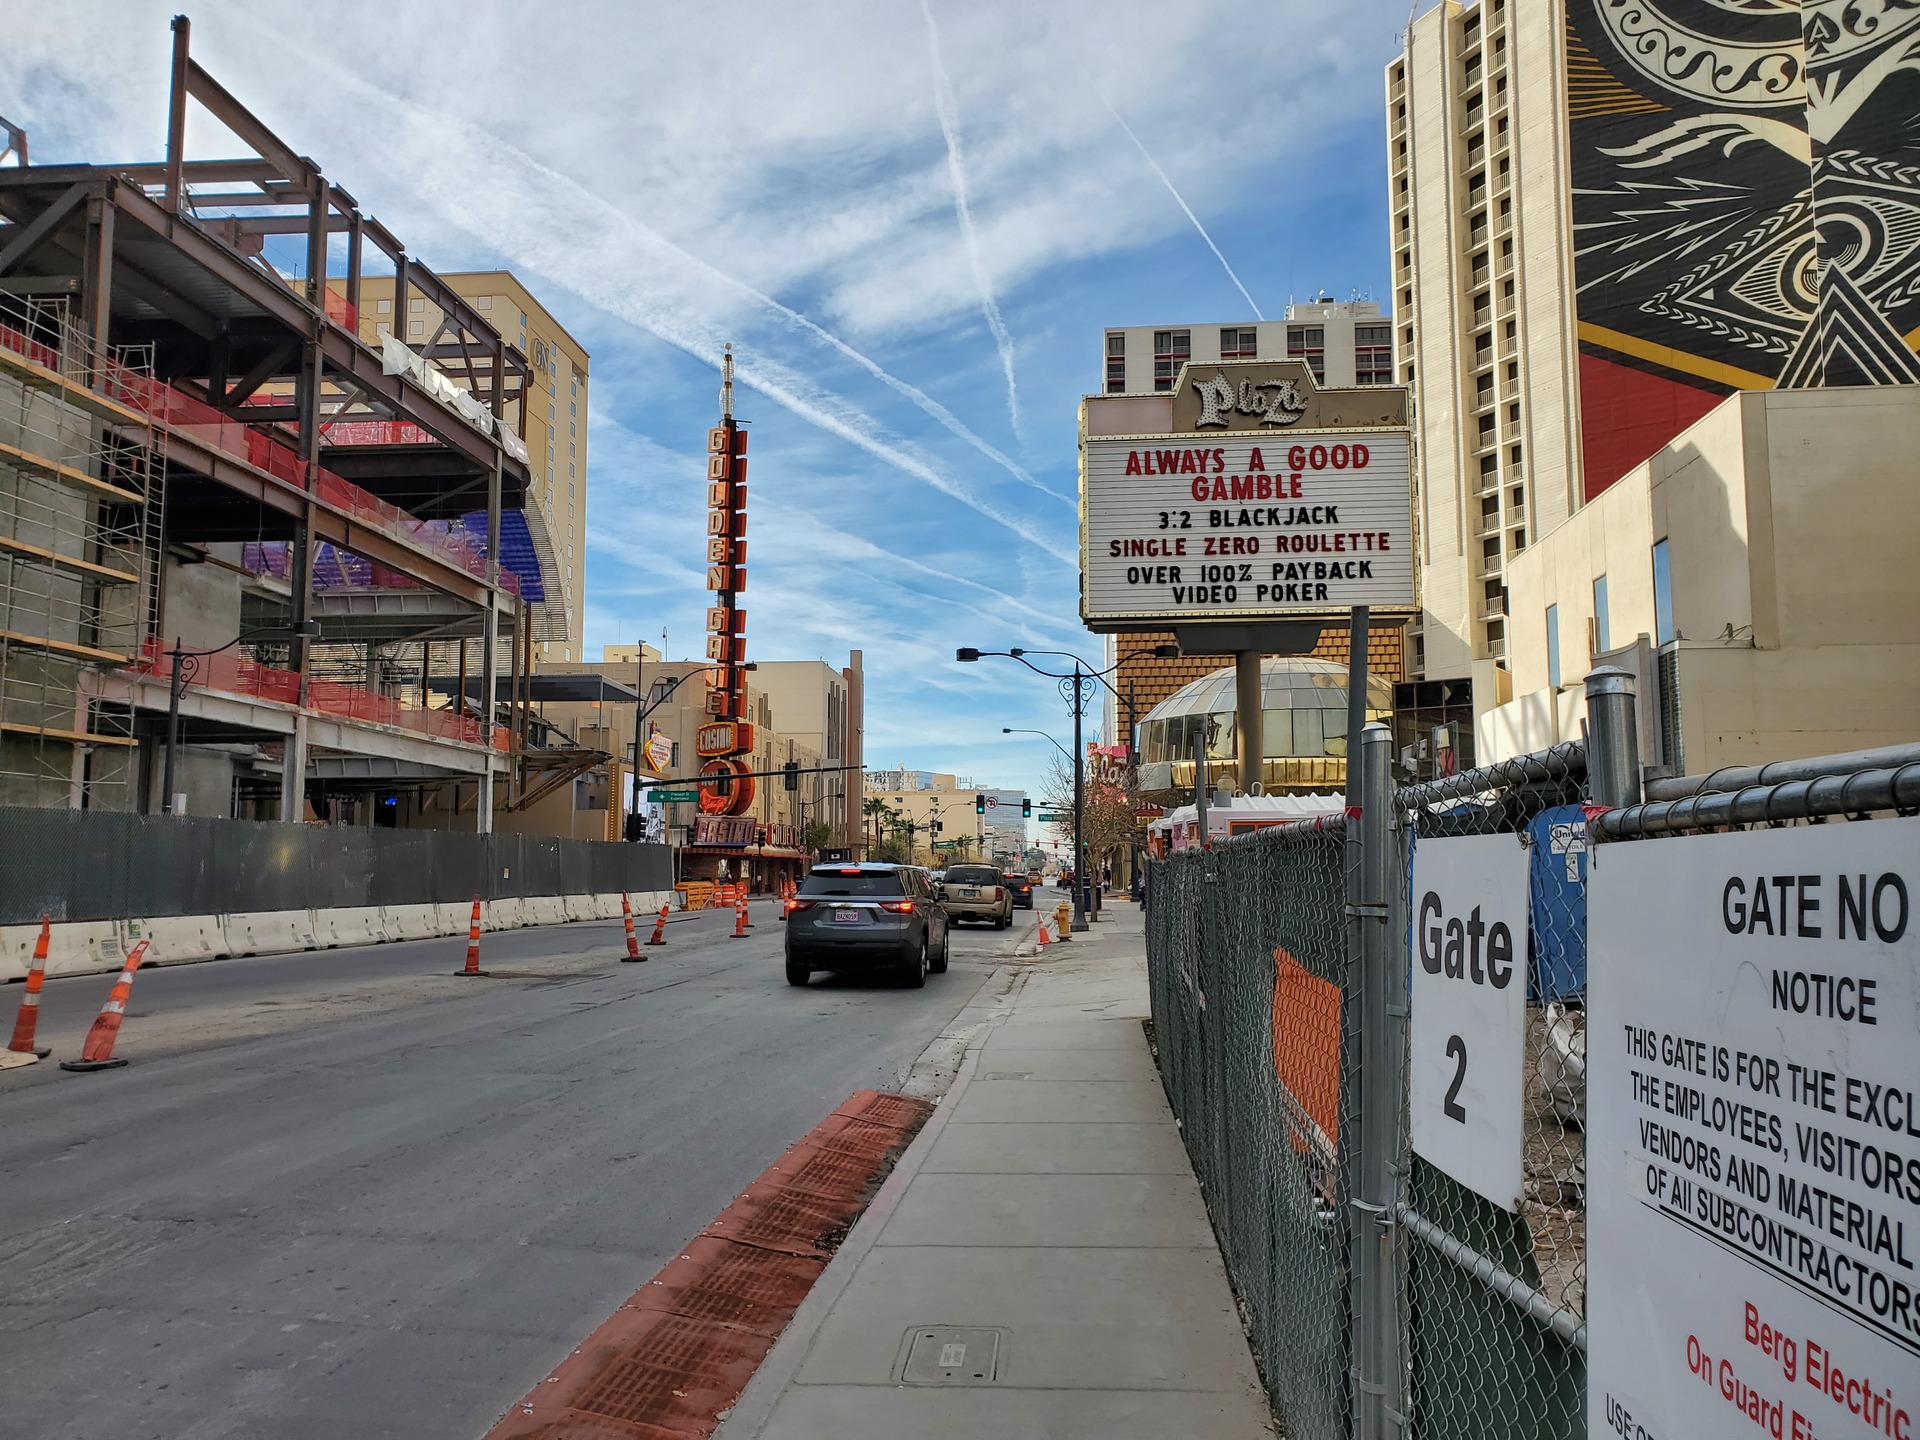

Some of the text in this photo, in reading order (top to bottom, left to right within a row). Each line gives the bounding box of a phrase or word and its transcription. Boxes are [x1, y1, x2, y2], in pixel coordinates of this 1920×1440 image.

[1809, 17, 1830, 43] A
[1126, 444, 1370, 476] ALWAYS A GOOD
[1191, 474, 1303, 502] GAMBLE
[1158, 506, 1339, 529] 3:2 BLACKJACK
[1110, 532, 1390, 558] SINGLE ZERO ROULETTE
[705, 427, 727, 715] GOLDEN GATE
[1127, 560, 1373, 585] OVER 100% PAYBACK
[1172, 583, 1328, 604] VIDEO POKER
[700, 726, 732, 751] CASINO
[696, 820, 755, 844] CASINO
[1723, 872, 1908, 944] GATE NO
[1419, 891, 1513, 990] Gate
[1772, 968, 1877, 1026] NOTICE
[1444, 1034, 1466, 1124] 2
[1624, 1025, 1657, 1062] THIS
[1662, 1034, 1706, 1076] GATE
[1712, 1046, 1730, 1082] IS
[1736, 1051, 1780, 1098] FOR
[1787, 1062, 1836, 1114] THE
[1630, 1070, 1660, 1109] THE
[1664, 1081, 1788, 1163] EMPLOYEES,
[1639, 1117, 1914, 1270] VENDORS AND MATERIAL
[1646, 1164, 1667, 1199] OF
[1686, 1334, 1712, 1386] On
[1719, 1358, 1784, 1440] Guard
[1744, 1300, 1911, 1440] Berg Electric
[1606, 1392, 1632, 1440] USE
